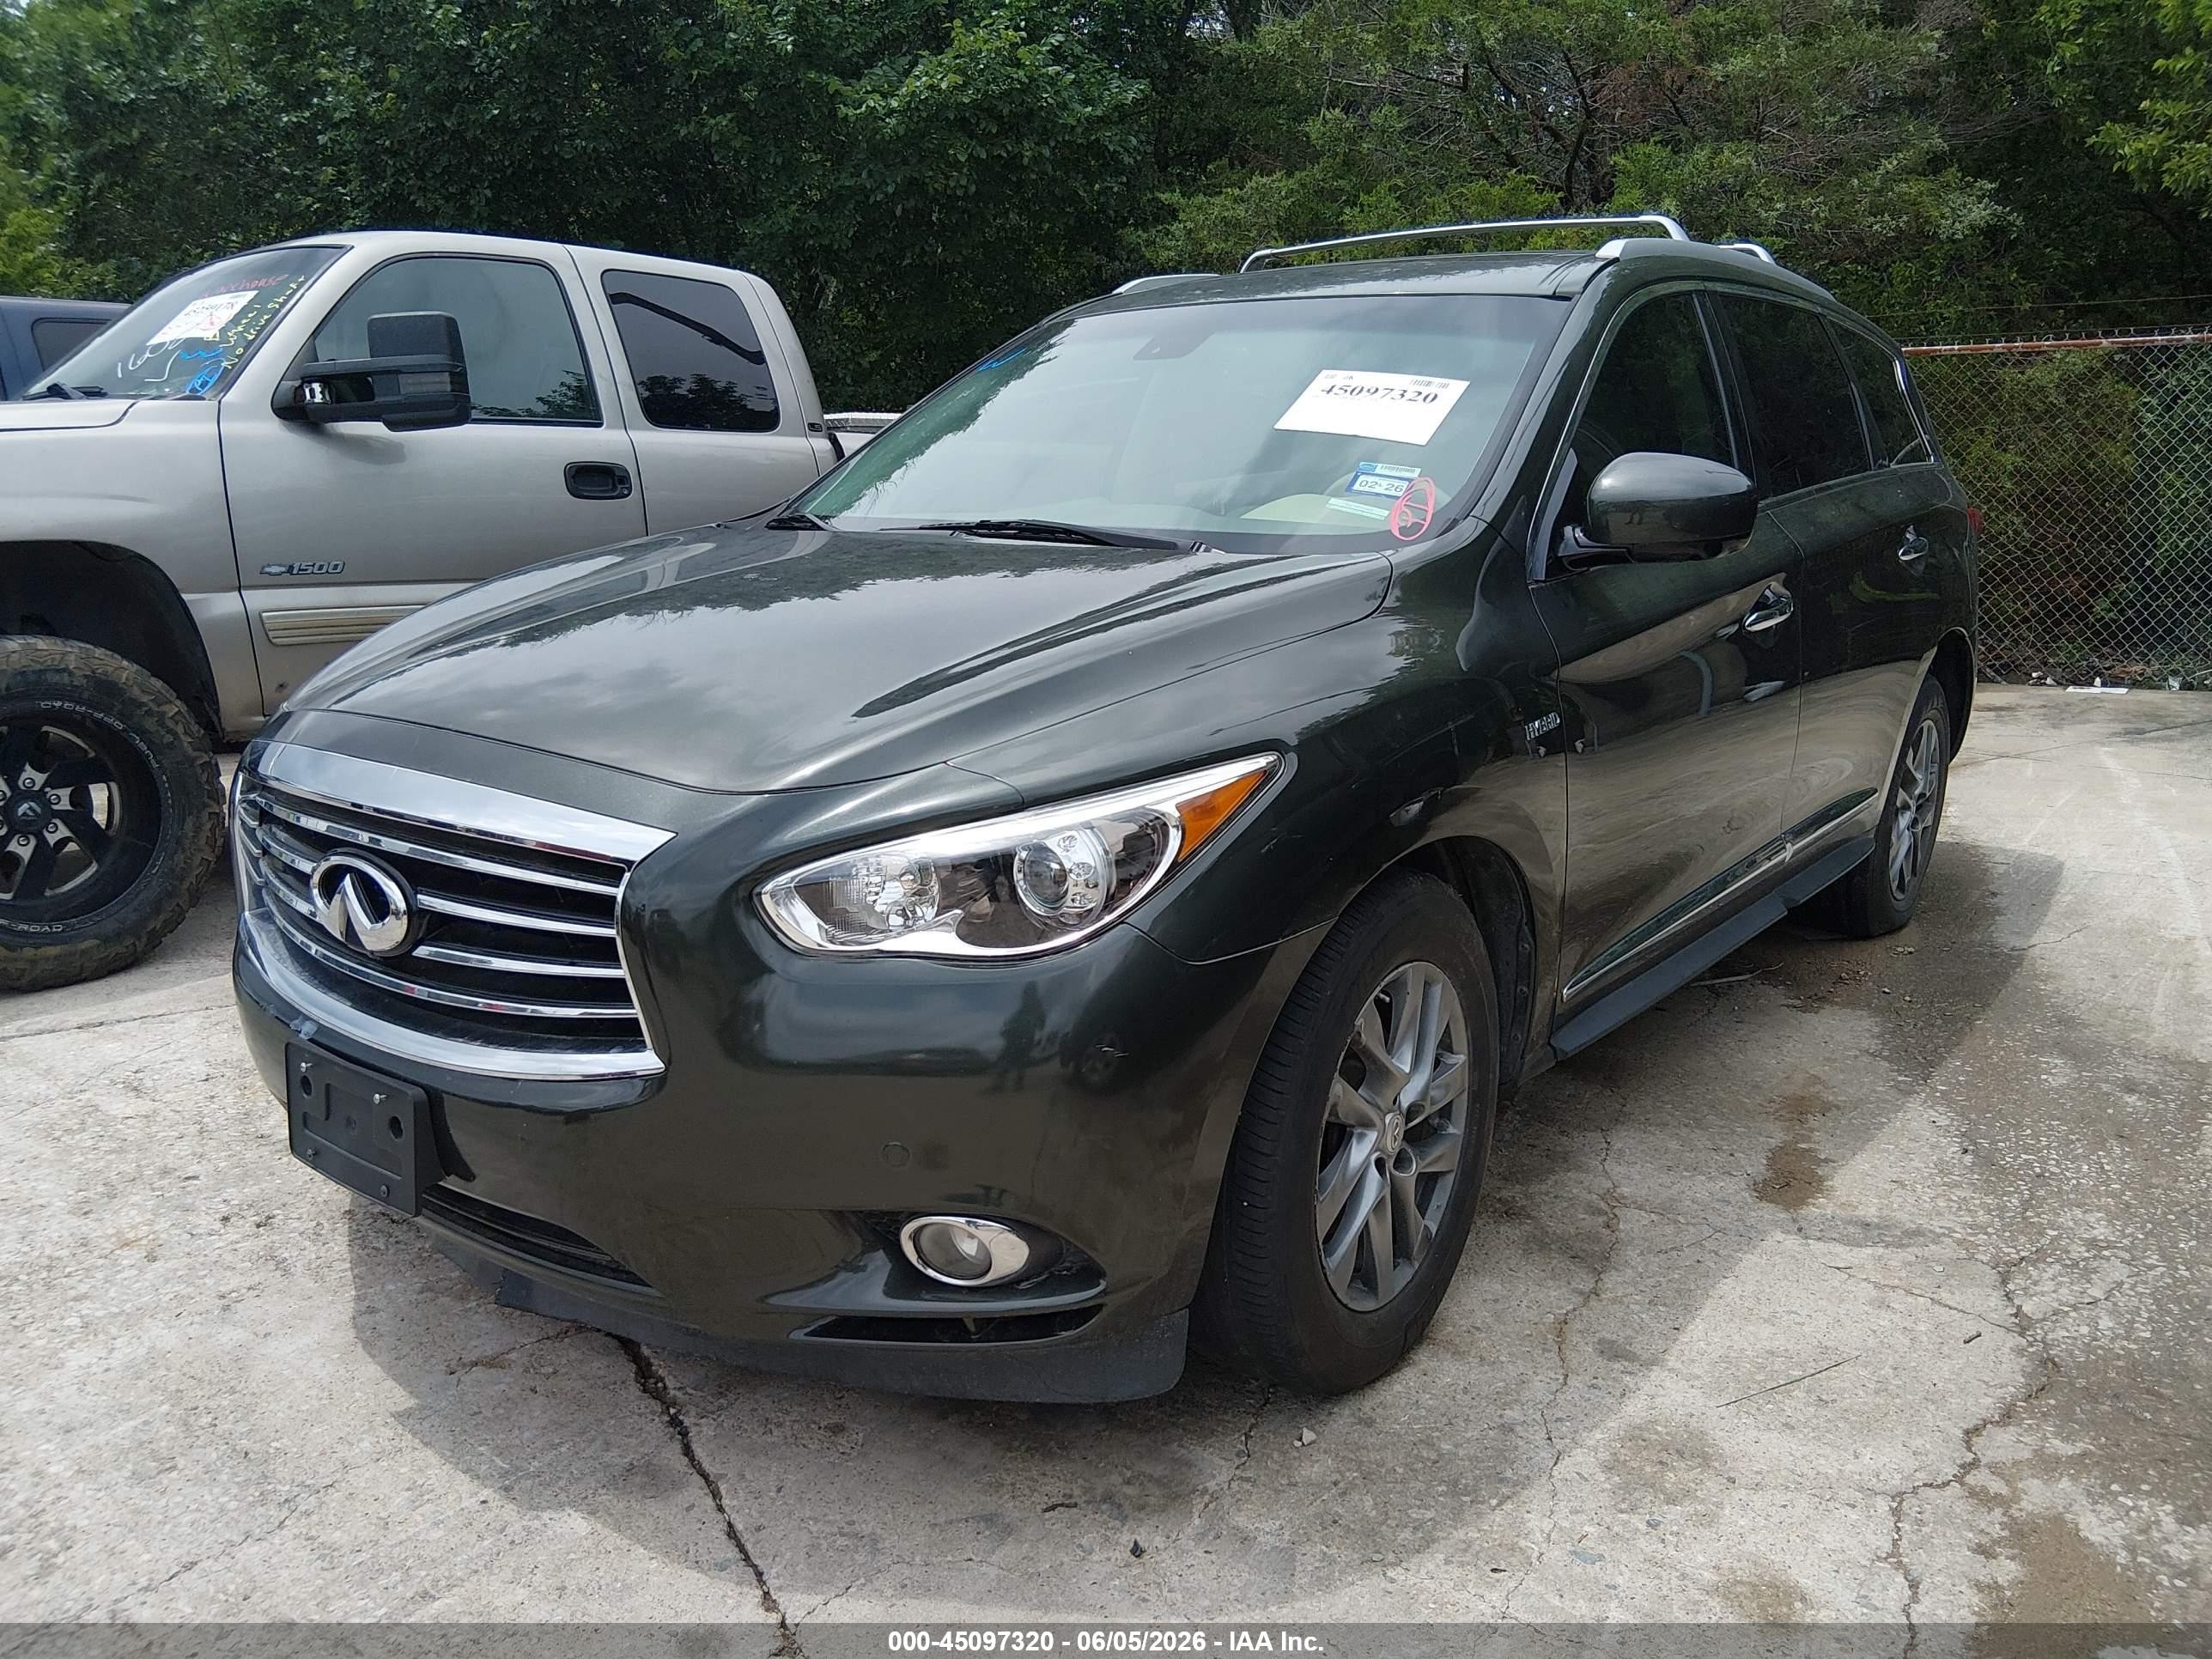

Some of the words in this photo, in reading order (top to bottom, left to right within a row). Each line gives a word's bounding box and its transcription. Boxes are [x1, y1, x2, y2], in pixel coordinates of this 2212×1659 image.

[1321, 384, 1438, 404] 45097320
[1359, 479, 1378, 489] 02
[1384, 483, 1404, 493] 26
[292, 562, 344, 574] 1500
